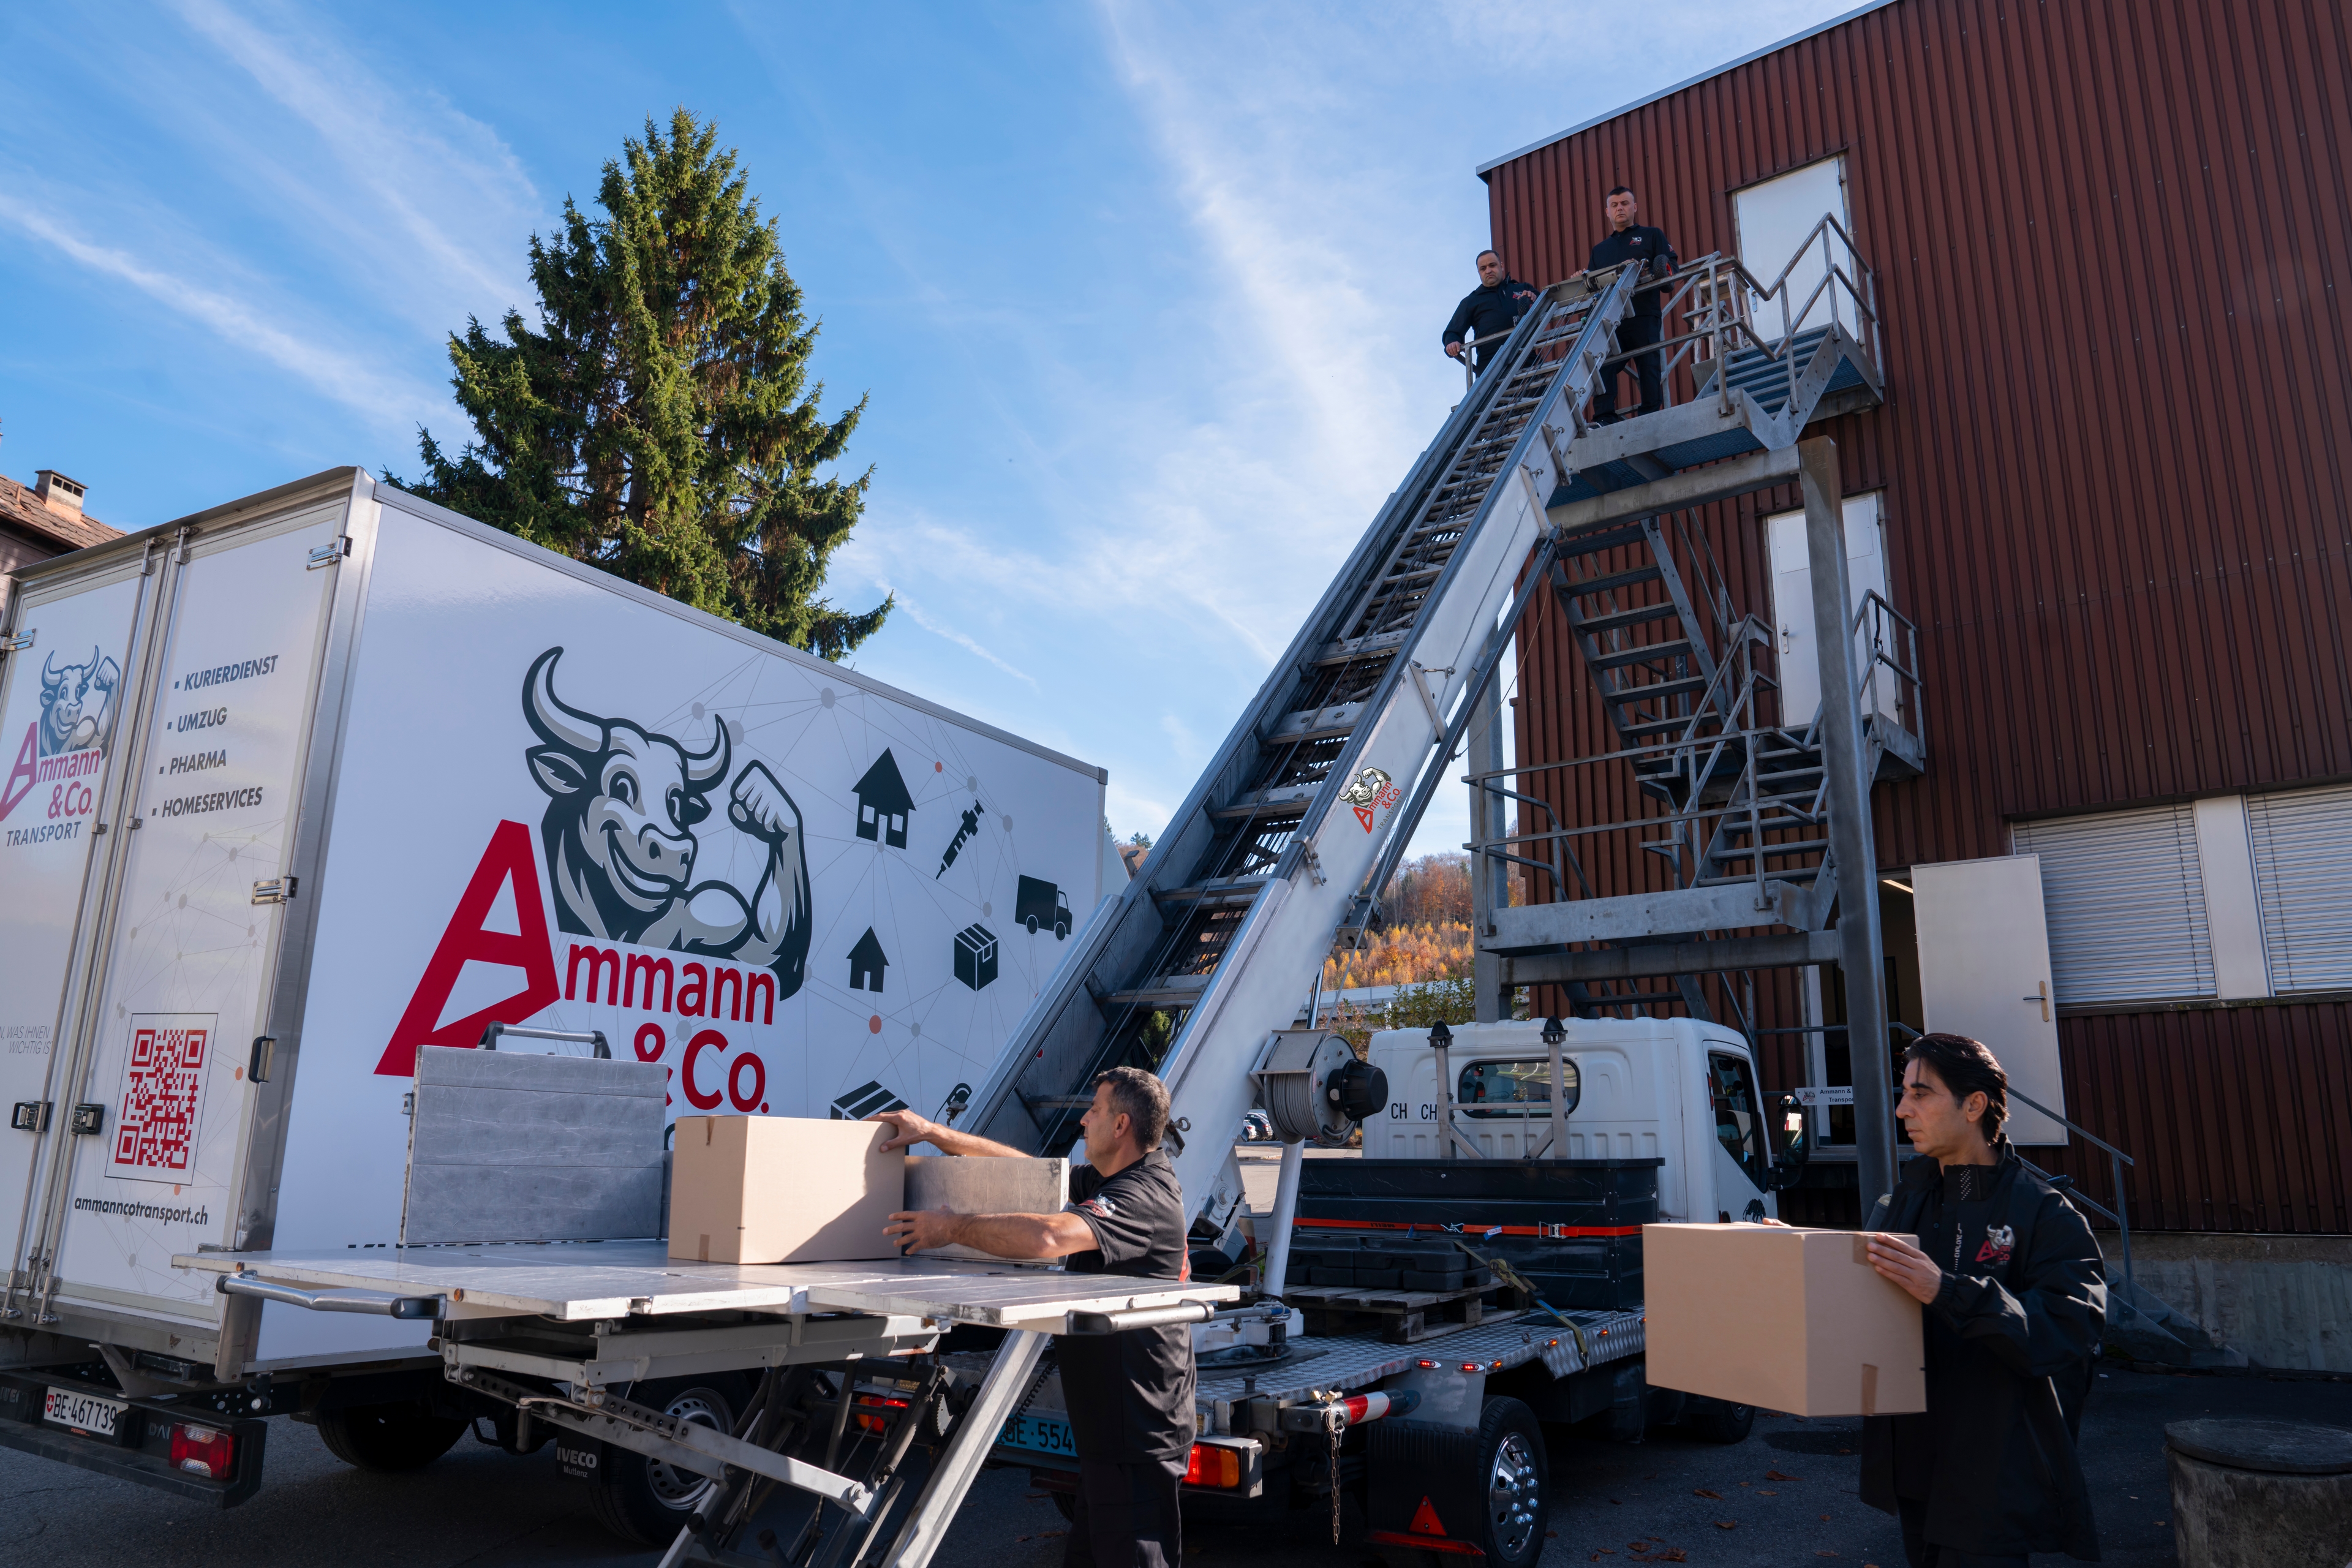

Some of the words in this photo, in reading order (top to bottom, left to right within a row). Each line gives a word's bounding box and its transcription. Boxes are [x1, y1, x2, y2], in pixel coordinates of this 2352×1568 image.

[184, 655, 279, 692] KURIERDIENST
[177, 707, 228, 733] UMZUG
[0, 722, 100, 821] Ammann
[169, 749, 227, 775] PHARMA
[48, 780, 93, 820] &Co.
[162, 786, 263, 818] HOMESERVICES
[1352, 780, 1393, 834] Ammann
[1381, 788, 1402, 809] &Co.
[1377, 794, 1404, 830] TRANSPORT
[6, 821, 81, 846] TRANSPORT
[373, 819, 775, 1077] Ammann
[7, 1026, 24, 1039] WAS
[24, 1026, 51, 1039] IHNEN
[9, 1041, 42, 1054] WICHTIG
[1391, 1102, 1408, 1120] CH
[1421, 1104, 1438, 1120] CH
[74, 1196, 208, 1226] ammanncotransport.ch
[556, 1446, 598, 1469] IVECO
[563, 1465, 589, 1479] Muttenz
